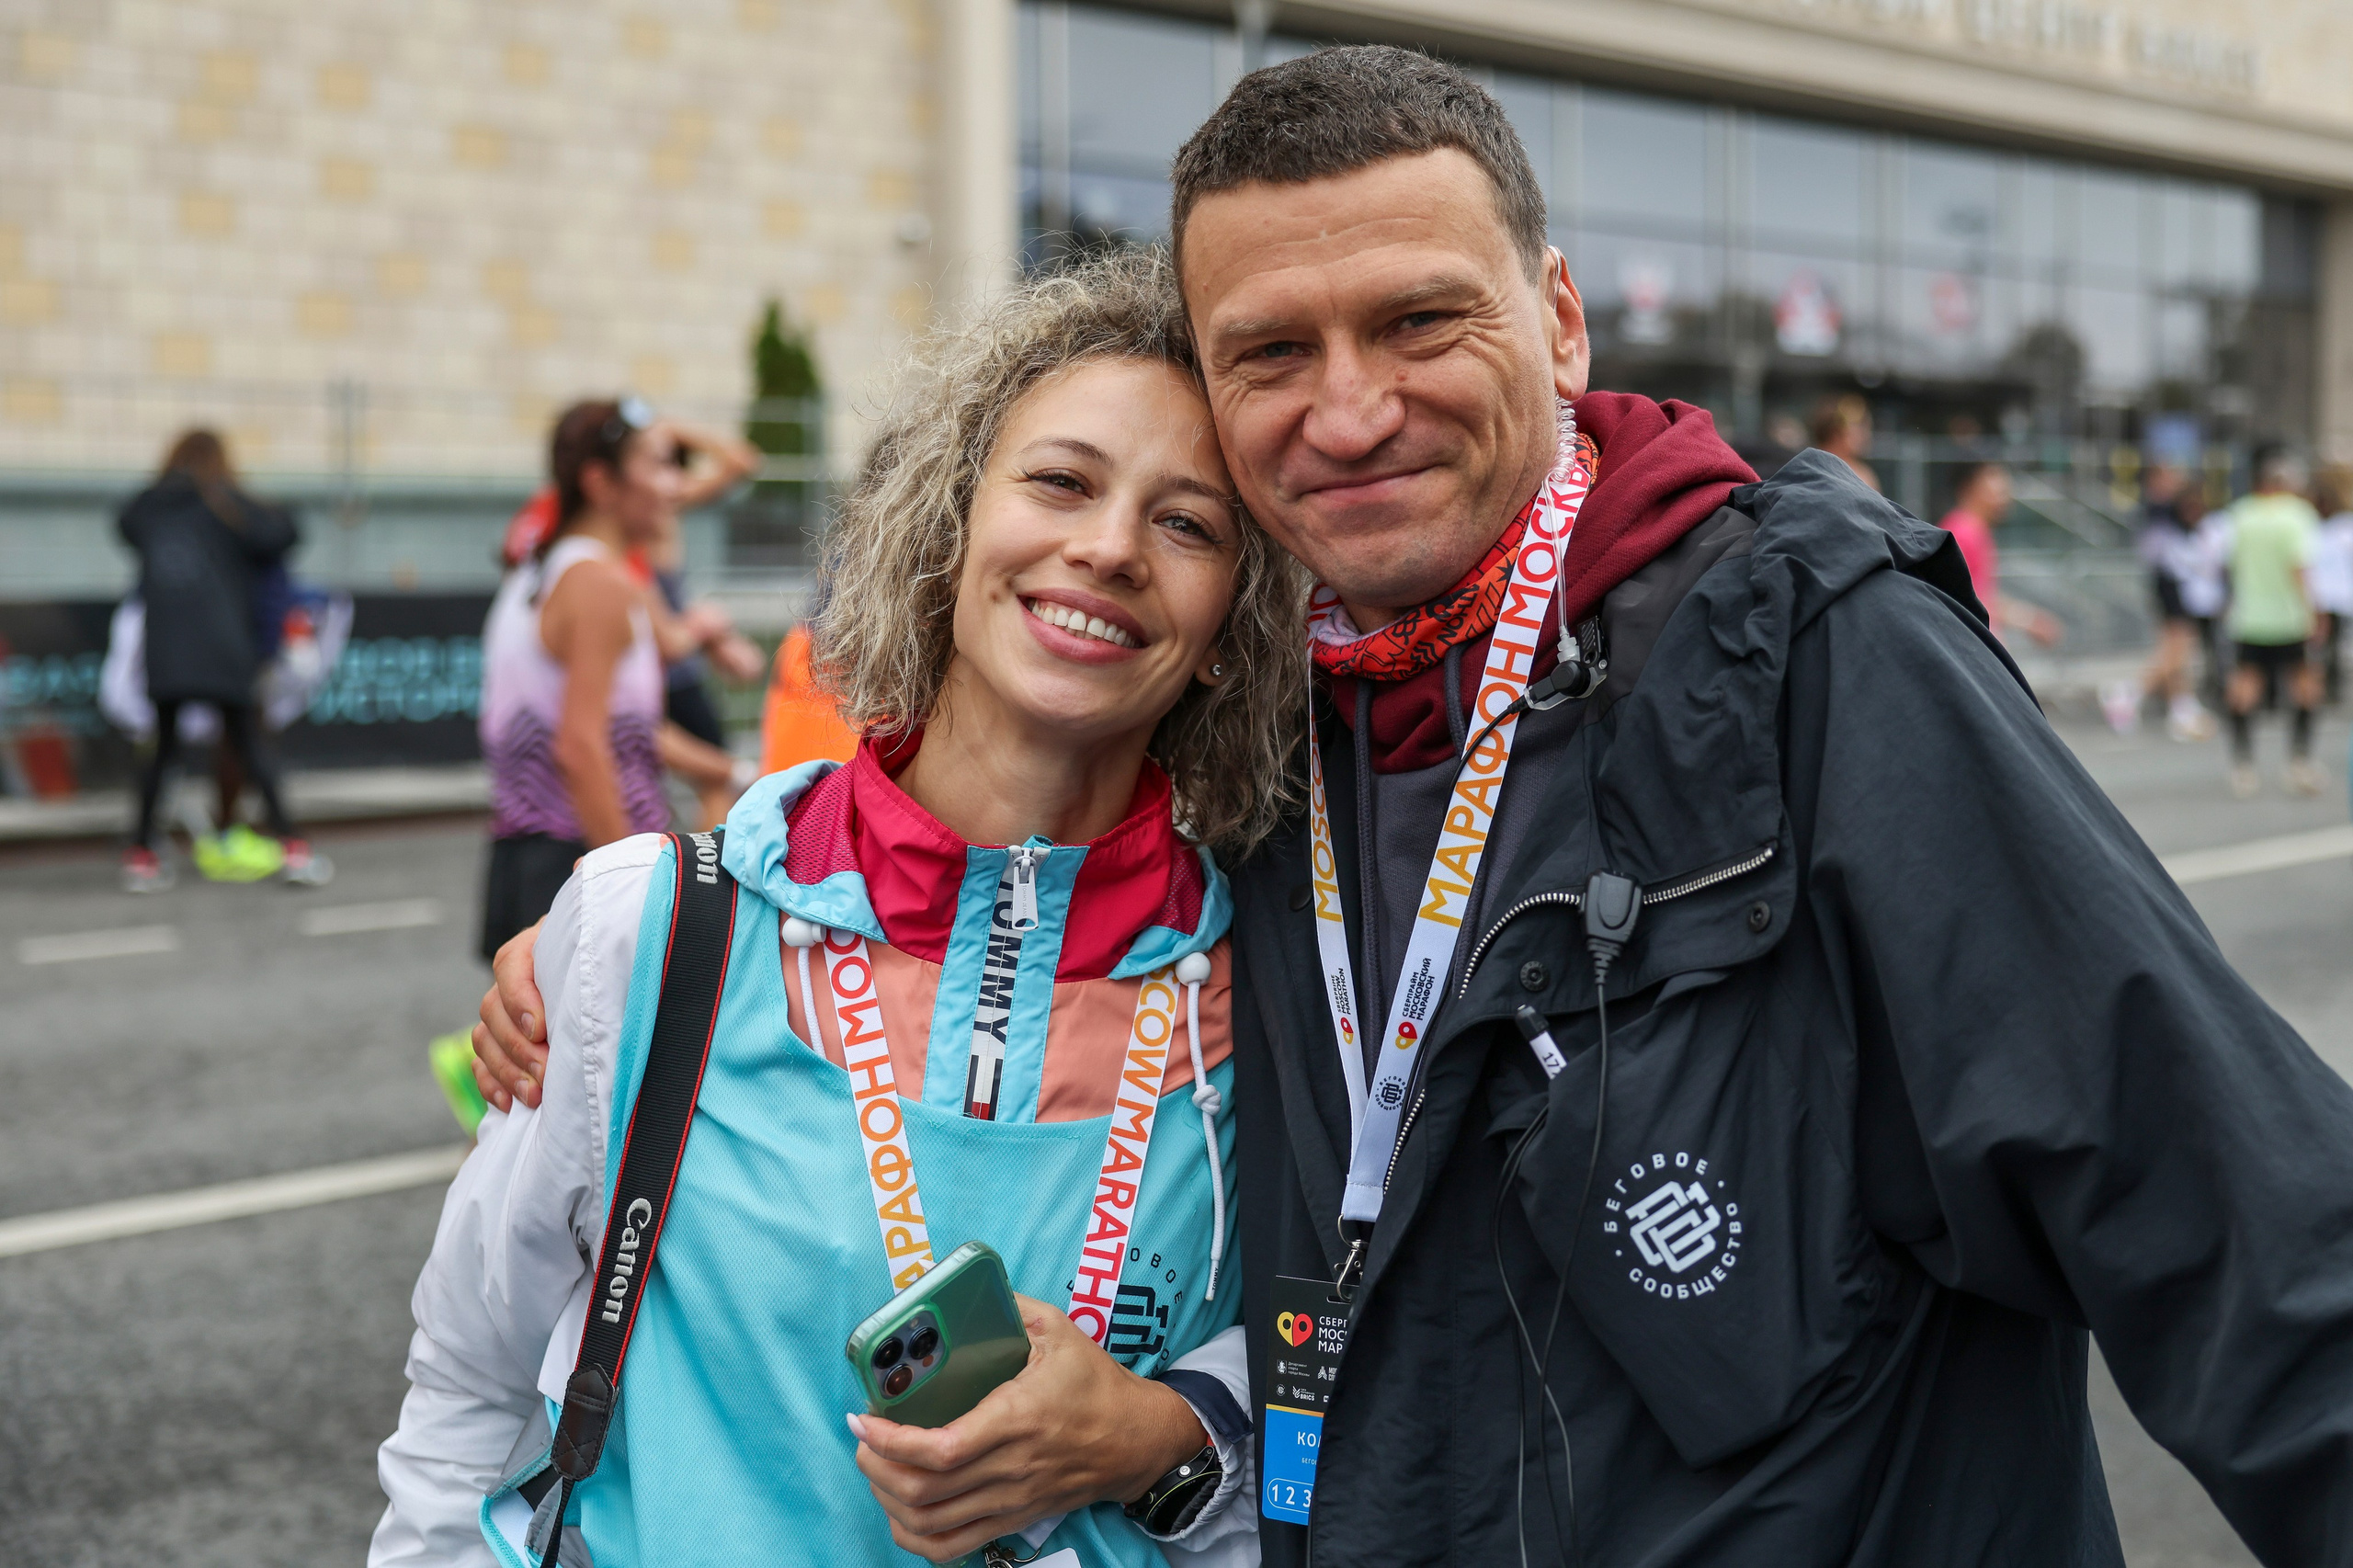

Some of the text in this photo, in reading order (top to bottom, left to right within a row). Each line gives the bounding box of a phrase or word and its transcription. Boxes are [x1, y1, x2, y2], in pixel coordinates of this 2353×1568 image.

[1418, 639, 1534, 928] МАРАФОН
[1335, 975, 1347, 1015] MOSCOW
[1337, 968, 1351, 1016] MARATHON
[1402, 971, 1419, 1017] СБЕРПРАЙМ
[1408, 958, 1431, 1019] МОСКОВСКИЙ
[1415, 976, 1435, 1021] МАРАФОН
[1604, 1152, 1709, 1233] БЕГОВОЕ
[601, 1198, 652, 1324] Canon
[1629, 1202, 1742, 1300] СООБЩЕСТВО
[1318, 1327, 1347, 1341] МОС
[1302, 1457, 1316, 1465] БЕГО
